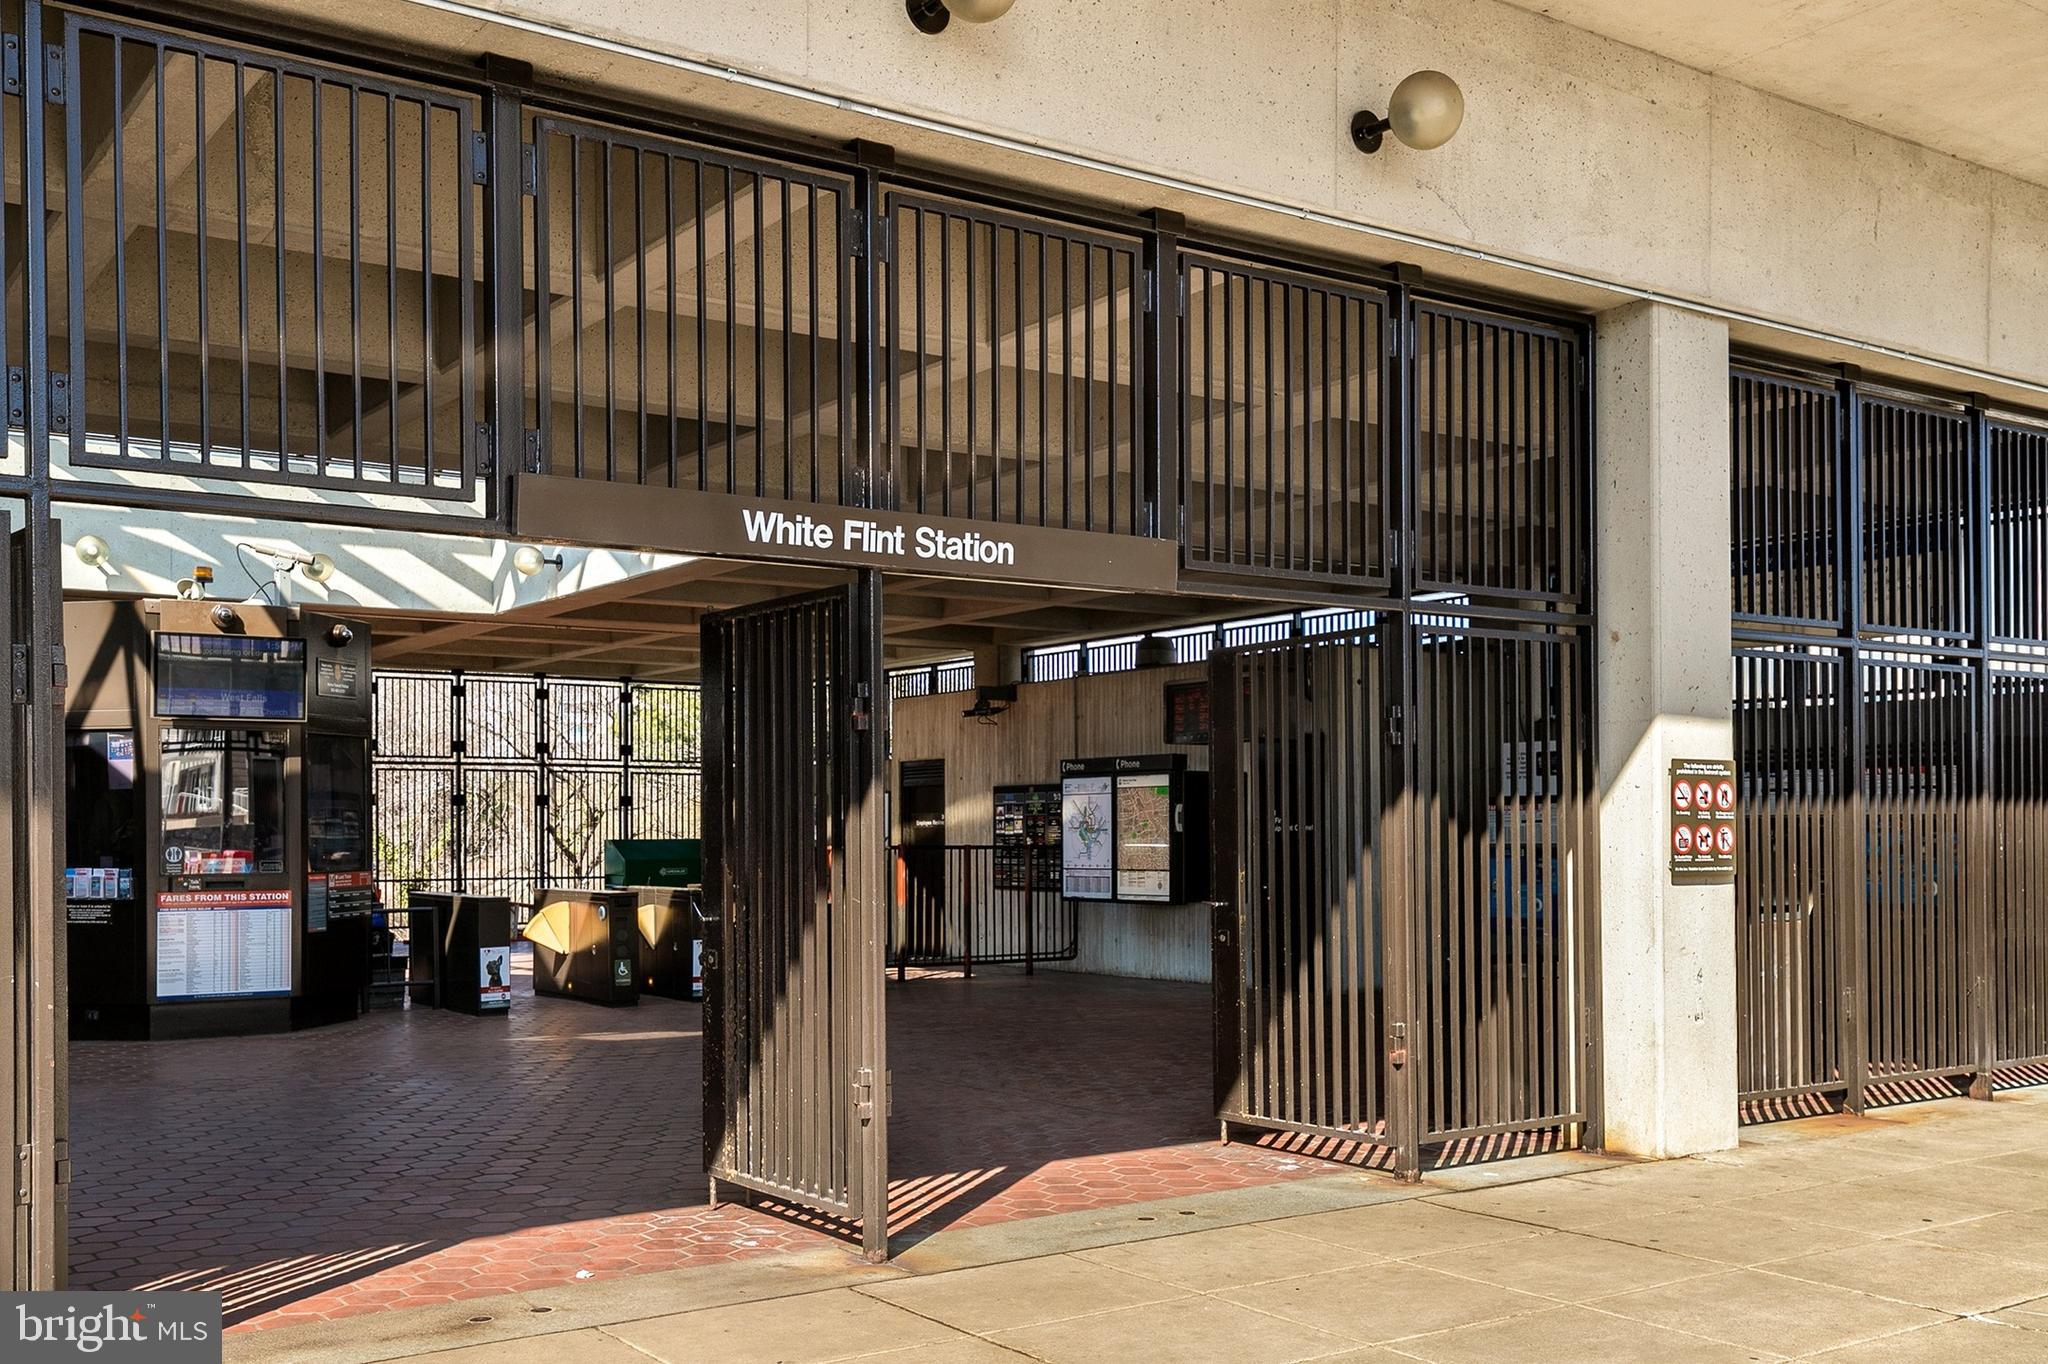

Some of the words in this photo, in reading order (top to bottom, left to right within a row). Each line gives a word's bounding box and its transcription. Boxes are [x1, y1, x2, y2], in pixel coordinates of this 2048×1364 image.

[742, 509, 833, 549] White
[843, 519, 906, 555] Flint
[915, 526, 1015, 565] Station
[221, 692, 244, 702] West
[246, 693, 268, 703] Falls
[1066, 763, 1085, 771] Phone
[1120, 760, 1140, 769] Phone
[160, 894, 192, 902] FARES
[194, 894, 222, 902] FROM
[224, 893, 247, 901] THIS
[249, 892, 289, 900] STATION
